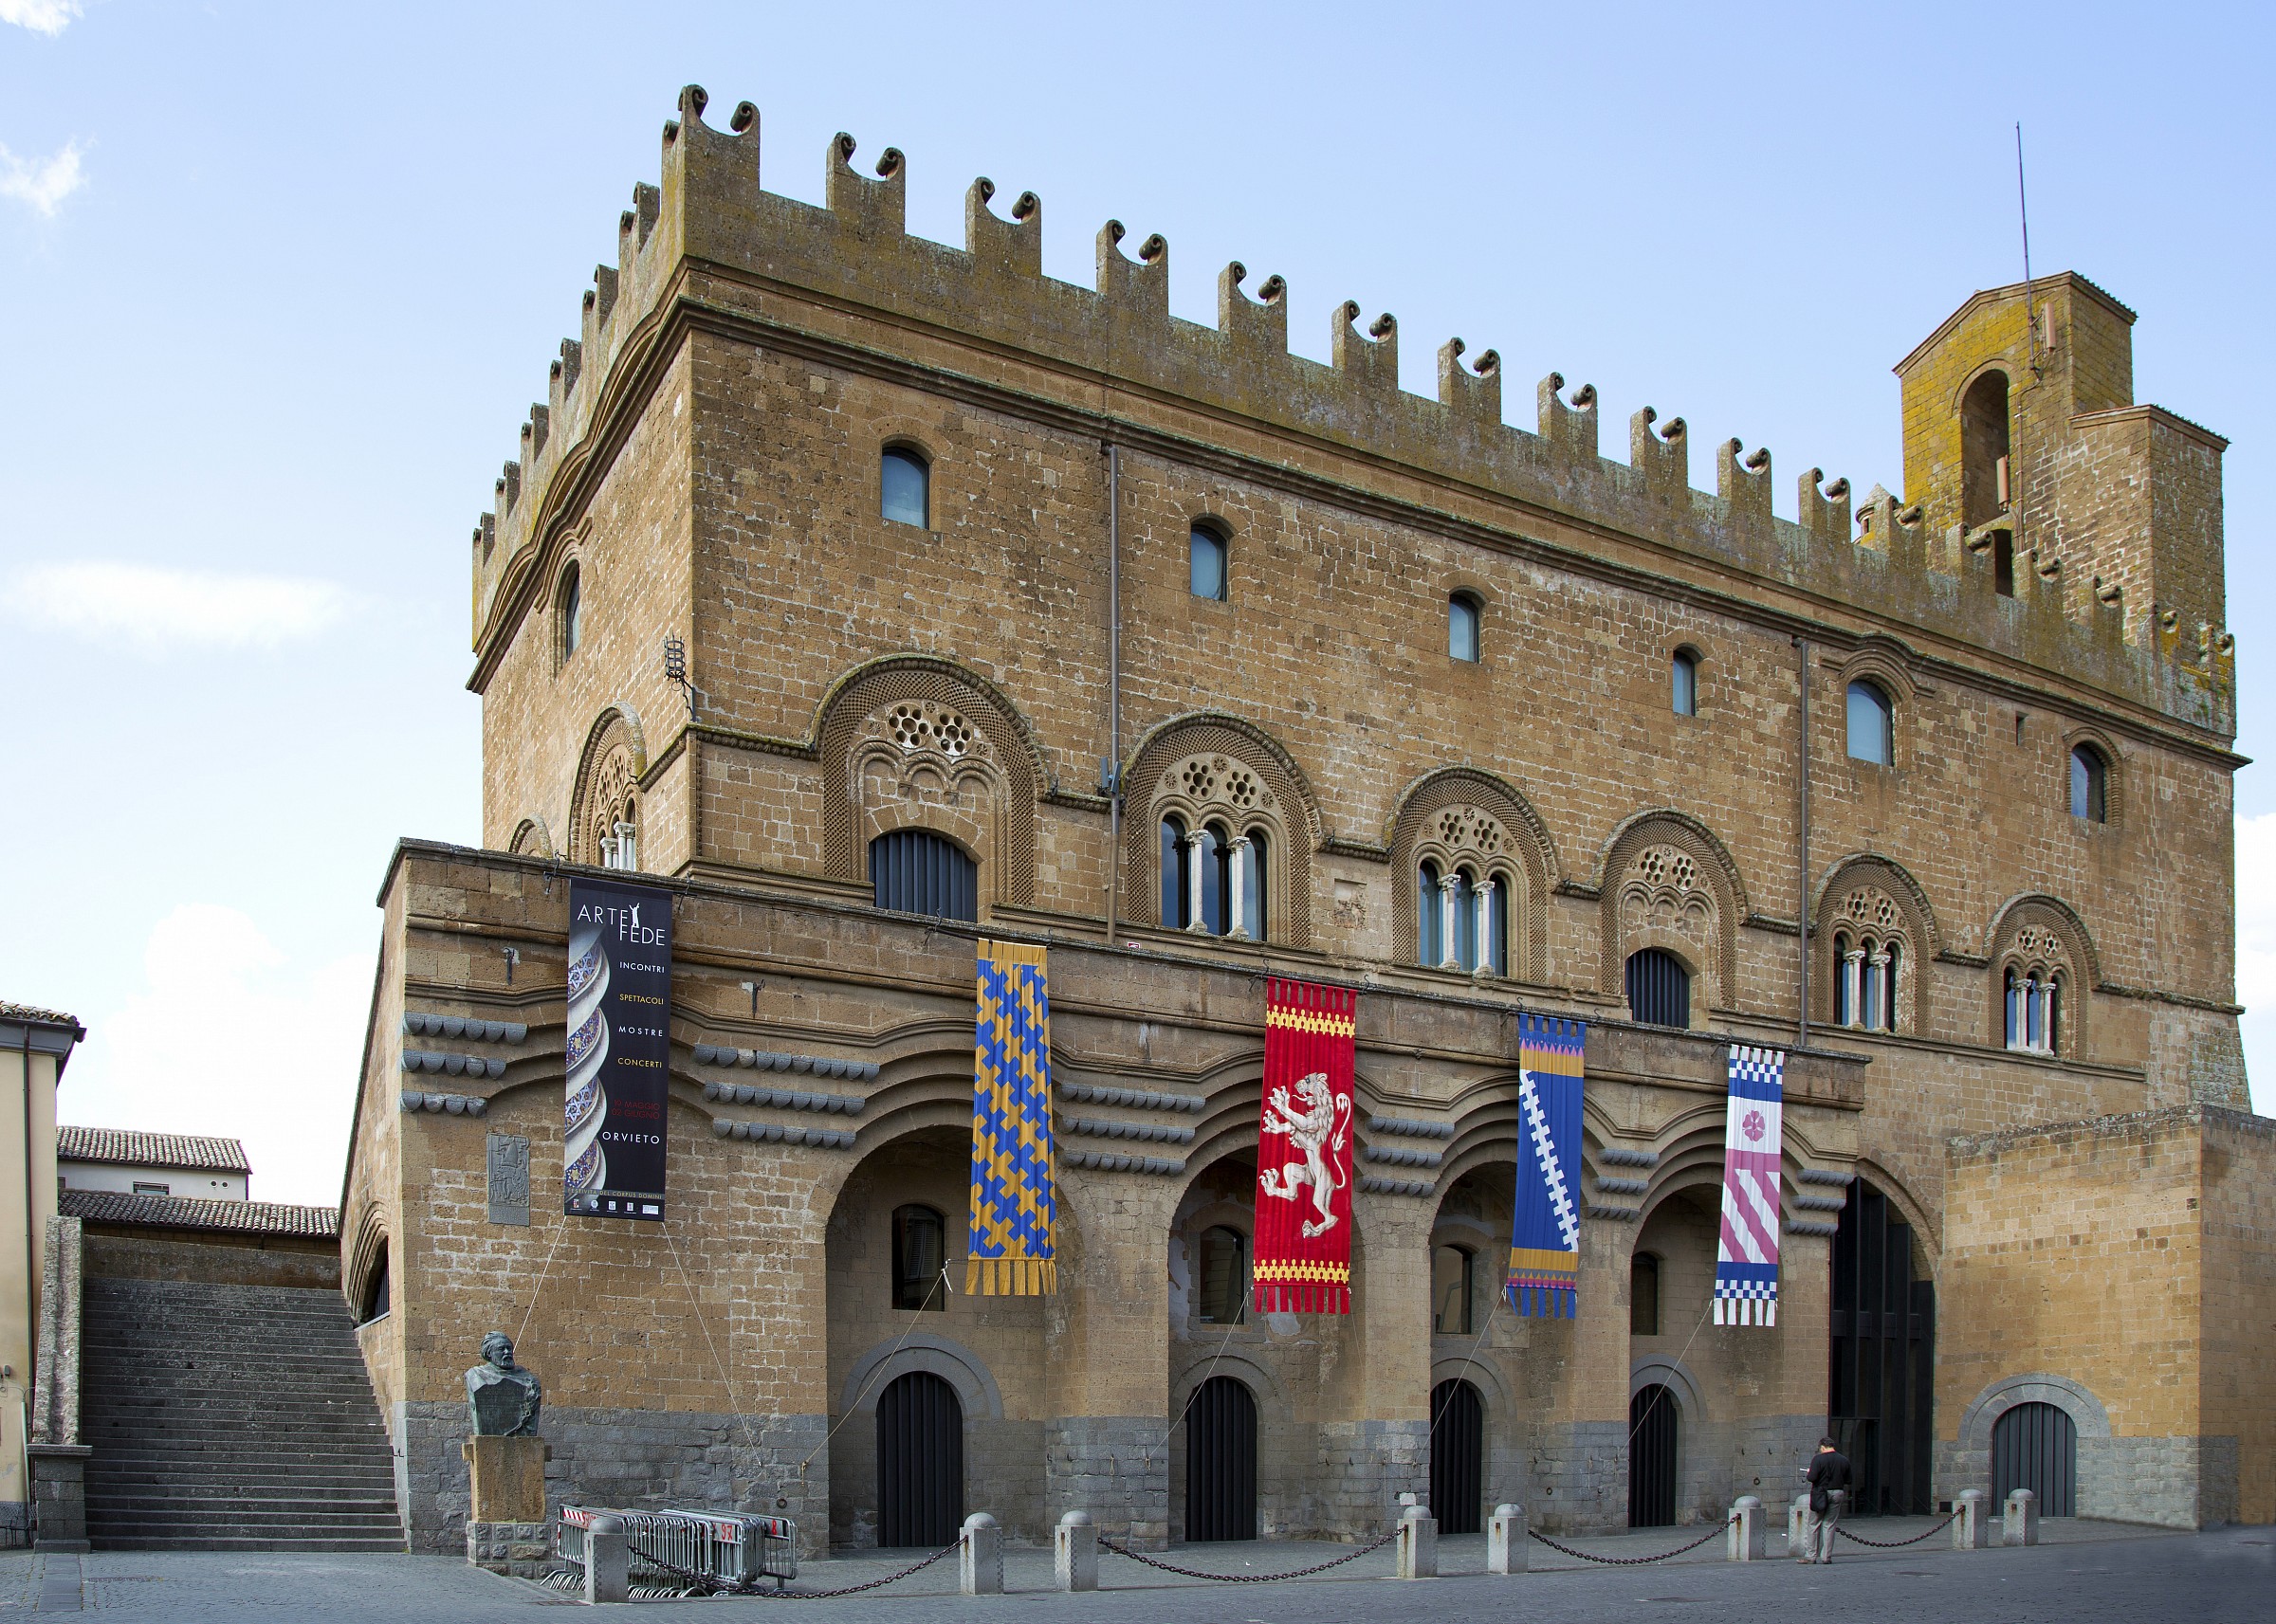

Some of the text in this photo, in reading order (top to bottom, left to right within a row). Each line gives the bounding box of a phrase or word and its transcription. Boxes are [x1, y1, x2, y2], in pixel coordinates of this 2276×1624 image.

[577, 903, 628, 925] ARTE
[619, 924, 665, 945] FEDE
[619, 961, 665, 973] INCONTRI
[619, 994, 664, 1005] SPETTACOLI
[618, 1026, 663, 1036] MOSTRE
[617, 1057, 662, 1068] CONCERTI
[624, 1101, 660, 1110] MAGGIO
[611, 1107, 660, 1120] 02 GIUGNO
[602, 1131, 660, 1143] ORVIETO
